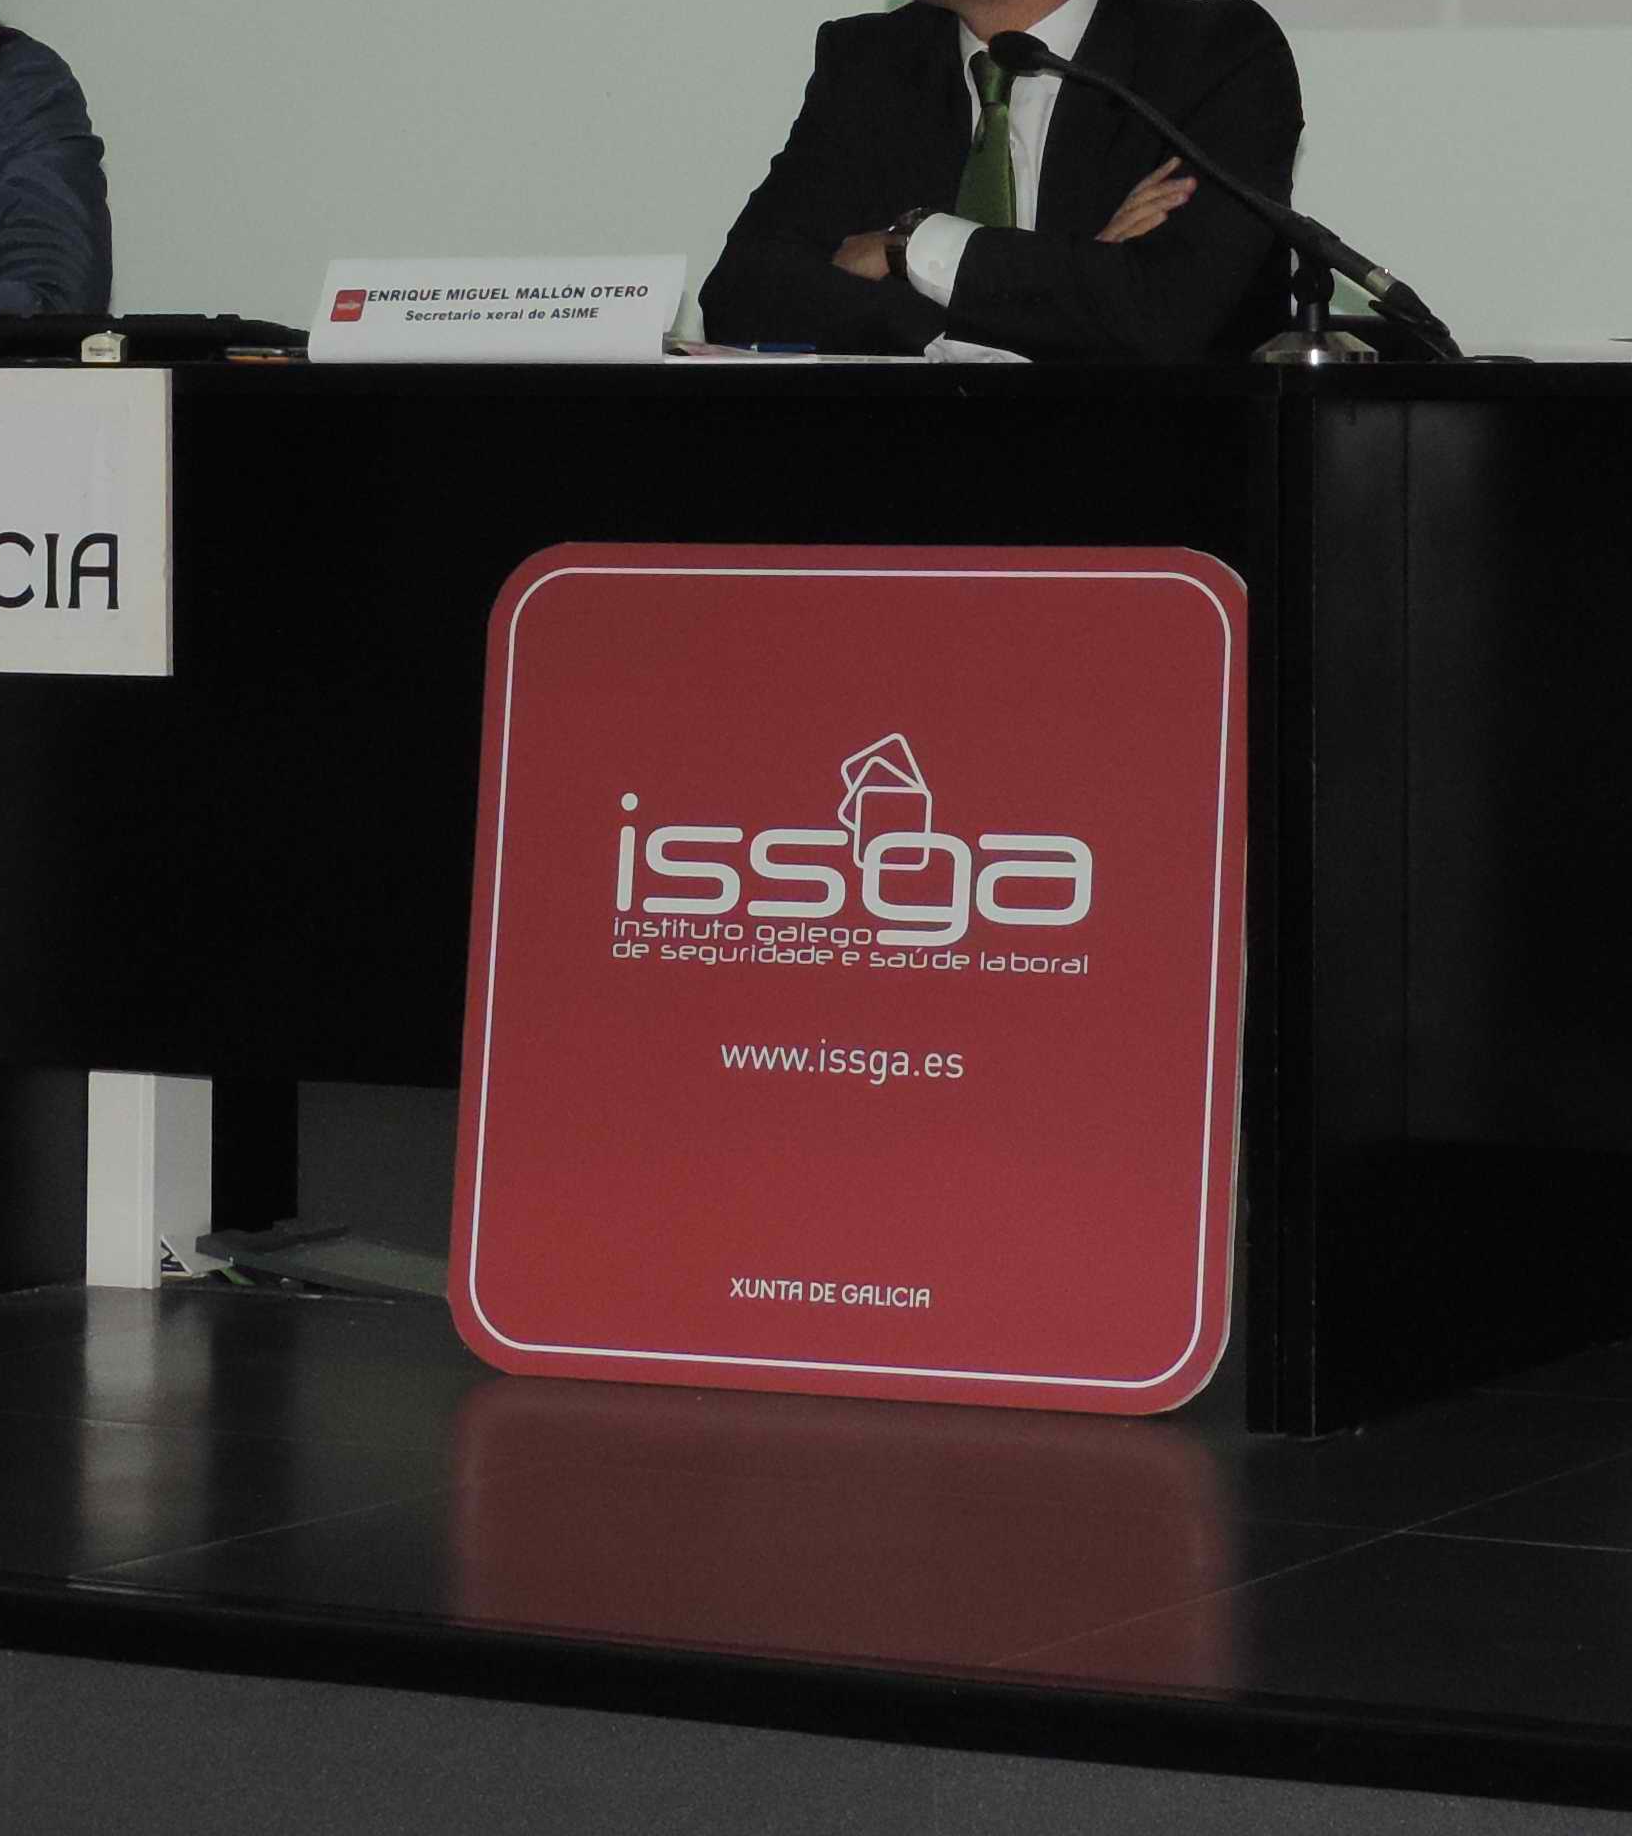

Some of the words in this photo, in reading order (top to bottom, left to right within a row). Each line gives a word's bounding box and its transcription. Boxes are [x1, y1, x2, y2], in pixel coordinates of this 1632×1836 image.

[367, 288, 442, 302] ENRIQUE
[445, 287, 510, 301] MIGUEL
[515, 283, 586, 300] MALLÓN
[590, 284, 649, 299] OTERO
[405, 309, 481, 321] Secretario
[485, 308, 524, 320] xeral
[527, 308, 546, 320] de
[550, 306, 600, 319] ASIME
[615, 791, 1094, 948] issga
[612, 915, 745, 943] instituto
[754, 919, 873, 949] galego
[611, 938, 650, 961] de
[660, 942, 834, 967] seguridade
[840, 949, 861, 966] e
[869, 947, 971, 972] saúde
[979, 950, 1089, 975] laboral
[721, 1038, 965, 1086] www.issga.es
[729, 1277, 804, 1302] XUNTA
[809, 1282, 837, 1304] DE
[841, 1283, 932, 1309] GALICIA
